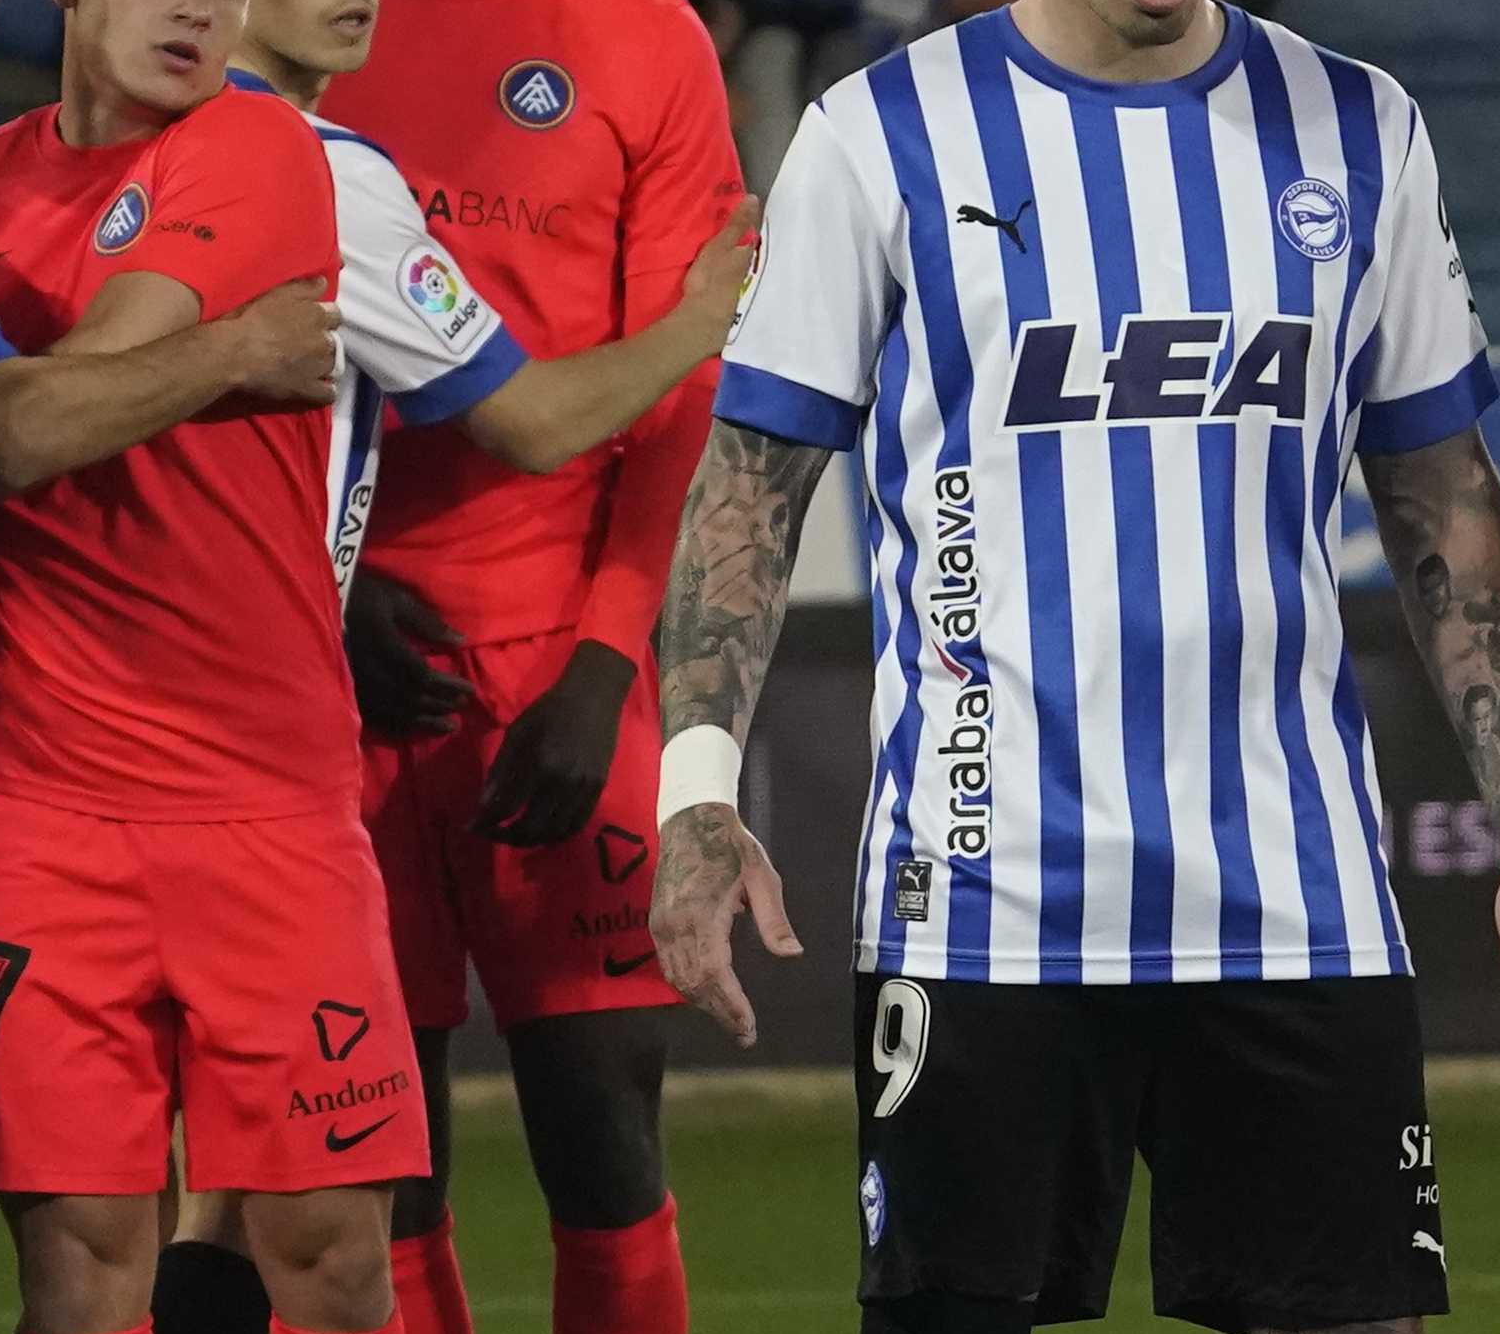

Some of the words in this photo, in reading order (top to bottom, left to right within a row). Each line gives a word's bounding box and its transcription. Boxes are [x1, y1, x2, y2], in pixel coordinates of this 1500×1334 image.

[408, 187, 571, 238] ABANC
[442, 297, 479, 340] LaLiga
[1002, 317, 1314, 428] LEA
[930, 469, 978, 638] álava
[937, 688, 990, 855] araba
[568, 903, 650, 939] Ando
[871, 979, 932, 1118] 9
[287, 1069, 410, 1120] Andorra
